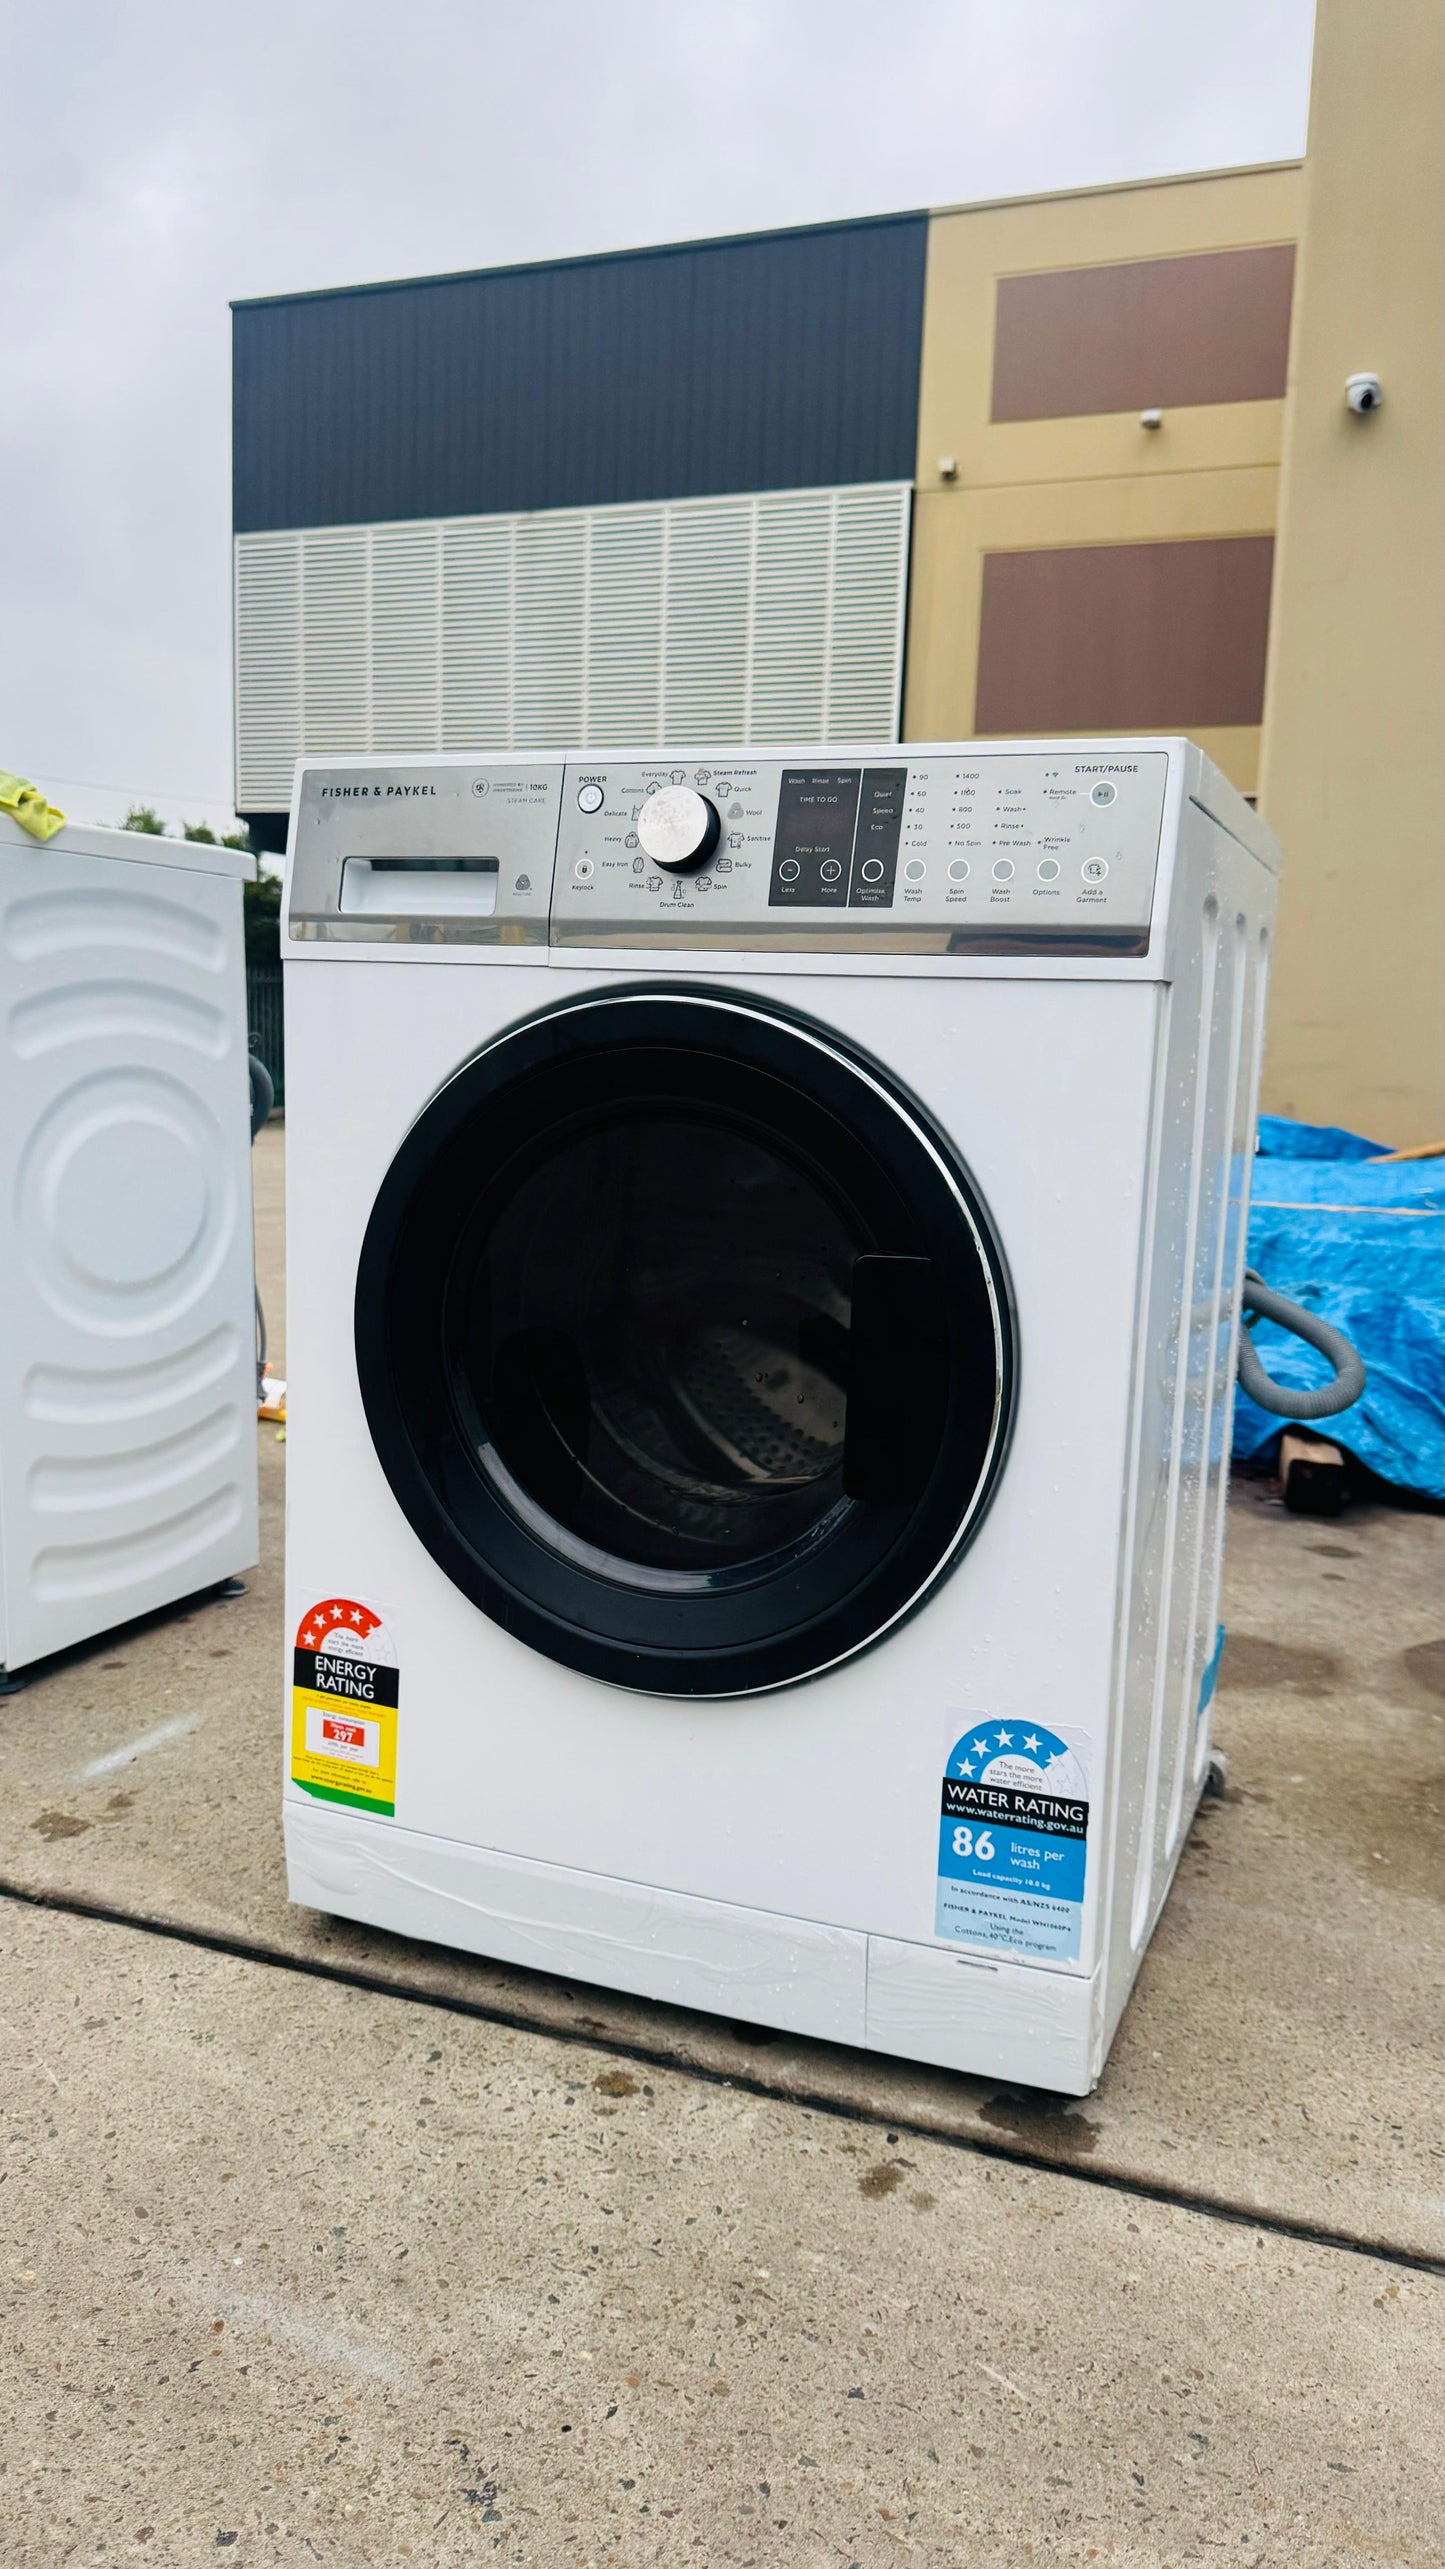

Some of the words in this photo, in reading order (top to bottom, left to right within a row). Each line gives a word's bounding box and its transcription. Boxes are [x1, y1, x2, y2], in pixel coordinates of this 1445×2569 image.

[641, 771, 669, 779] Everyday
[1074, 765, 1140, 774] START/PAUSE
[321, 787, 369, 797] FISHER
[373, 786, 381, 797] &
[387, 785, 436, 796] PAYKEL
[529, 783, 548, 791] 10KG
[872, 807, 894, 815] Speed
[795, 846, 813, 854] Delay
[735, 861, 752, 869] Bulky
[571, 884, 594, 892] Keylock
[856, 887, 885, 895] Optimise
[1032, 888, 1060, 896] Options
[1076, 896, 1107, 904] Garment
[315, 1655, 377, 1682] ENERGY
[316, 1672, 375, 1700] RATING
[333, 1728, 354, 1743] 297
[999, 1761, 1013, 1769] The
[1014, 1764, 1035, 1774] more
[989, 1768, 1007, 1778] stars
[1008, 1770, 1022, 1779] the
[1022, 1774, 1043, 1784] more
[990, 1776, 1011, 1786] water
[1013, 1779, 1042, 1792] efficient
[947, 1784, 1010, 1809] WATER
[1014, 1795, 1084, 1821] RATING
[946, 1801, 1085, 1834] www.waterrating.gov.au
[952, 1826, 996, 1861] 86
[1010, 1842, 1041, 1858] litres
[1044, 1850, 1065, 1862] per
[1010, 1858, 1040, 1870] wash
[972, 1869, 991, 1880] Load
[992, 1873, 1023, 1885] capacity
[1041, 1881, 1051, 1891] kg
[960, 1888, 1000, 1900] accordance
[1002, 1895, 1019, 1904] with
[943, 1902, 969, 1913] FISHER
[971, 1907, 977, 1915] &
[978, 1909, 1007, 1921] PAYKEL
[1009, 1915, 1031, 1925] Model
[989, 1922, 1010, 1934] Using
[1011, 1926, 1024, 1935] the
[1024, 1940, 1056, 1952] program
